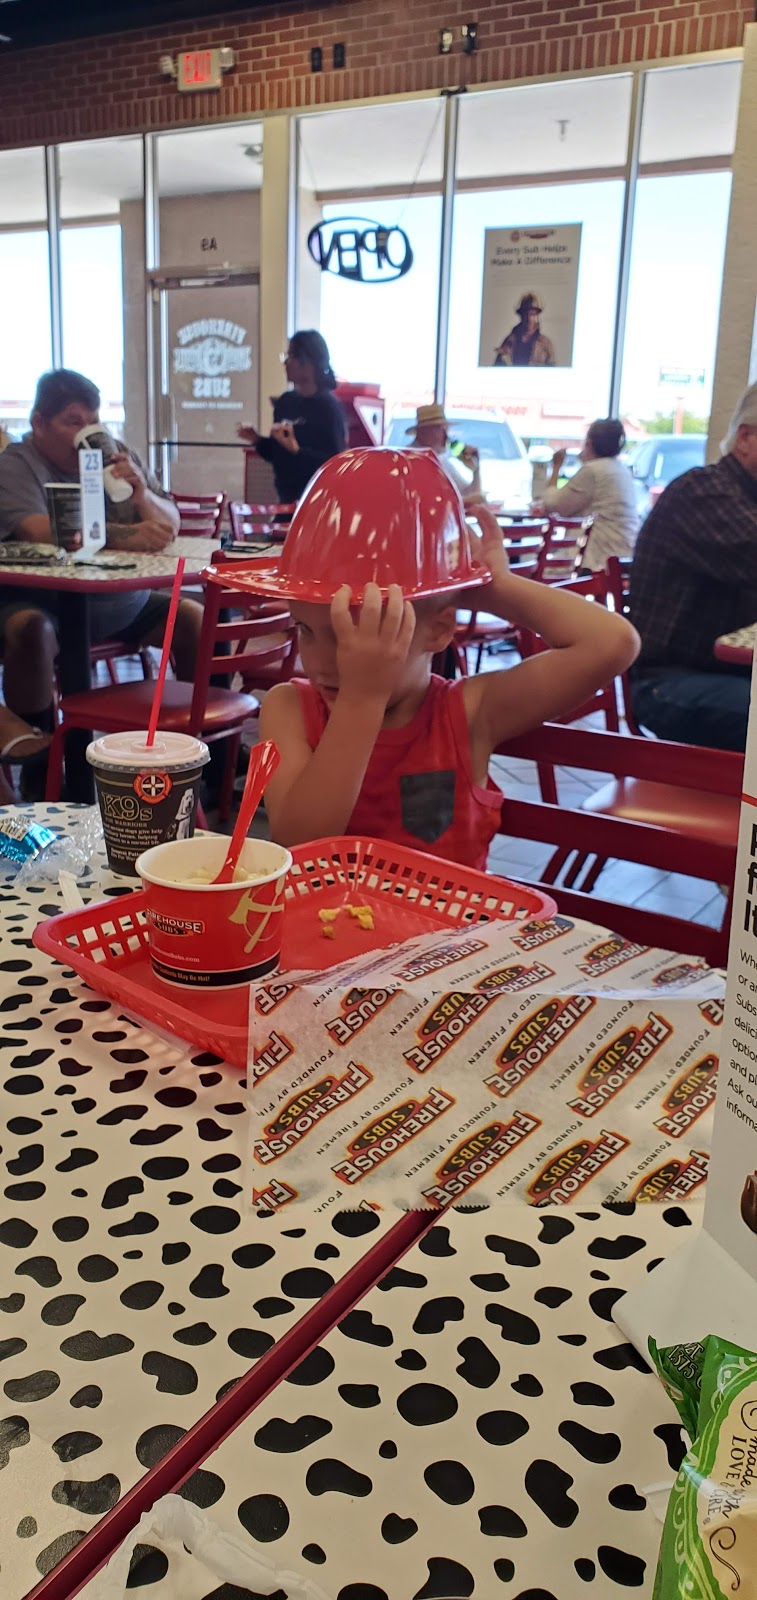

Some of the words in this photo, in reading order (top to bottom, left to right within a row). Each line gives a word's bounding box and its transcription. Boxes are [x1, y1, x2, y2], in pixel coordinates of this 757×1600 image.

[525, 256, 571, 266] Difference
[85, 453, 98, 470] 23
[392, 938, 486, 981] FIREHOUSE
[485, 968, 518, 987] SUBS
[738, 974, 748, 986] or
[389, 997, 429, 1037] FIREMEN
[507, 1012, 518, 1026] BY
[509, 1012, 550, 1054] SUBS
[596, 1000, 635, 1041] FOUNDED
[468, 1026, 507, 1066] FIREMEN
[483, 995, 593, 1096] FIREHOUSE
[585, 1041, 597, 1055] BY
[589, 1041, 628, 1081] SUBS
[675, 1029, 711, 1068] FOUNDED
[291, 1049, 335, 1089] FOUNDED
[549, 1055, 585, 1092] FIREMEN
[566, 1011, 670, 1117] FIREHOUSE
[664, 1069, 676, 1080] BY
[729, 1058, 748, 1079] and
[277, 1089, 290, 1102] BY
[373, 1077, 415, 1111] FOUNDED
[635, 1081, 667, 1111] FIREMEN
[674, 1067, 709, 1101] SUBS
[727, 1077, 744, 1098] Ask
[253, 1061, 371, 1164] FIREHOUSE
[278, 1088, 323, 1127] SUBS
[360, 1110, 372, 1121] BY
[458, 1101, 498, 1133] FOUNDED
[316, 1120, 359, 1156] FIREMEN
[330, 1086, 452, 1184] FIREHOUSE
[362, 1110, 406, 1144] SUBS
[446, 1133, 458, 1144] BY
[546, 1120, 584, 1151] FOUNDED
[404, 1145, 446, 1179] FIREMEN
[421, 1110, 539, 1207] FIREHOUSE
[451, 1132, 493, 1168] SUBS
[535, 1151, 548, 1163] BY
[542, 1149, 582, 1185] SUBS
[637, 1140, 672, 1171] FOUNDED
[496, 1163, 536, 1197] FIREMEN
[628, 1170, 639, 1181] BY
[636, 1171, 674, 1203] SUBS
[726, 1434, 748, 1480] LOVE
